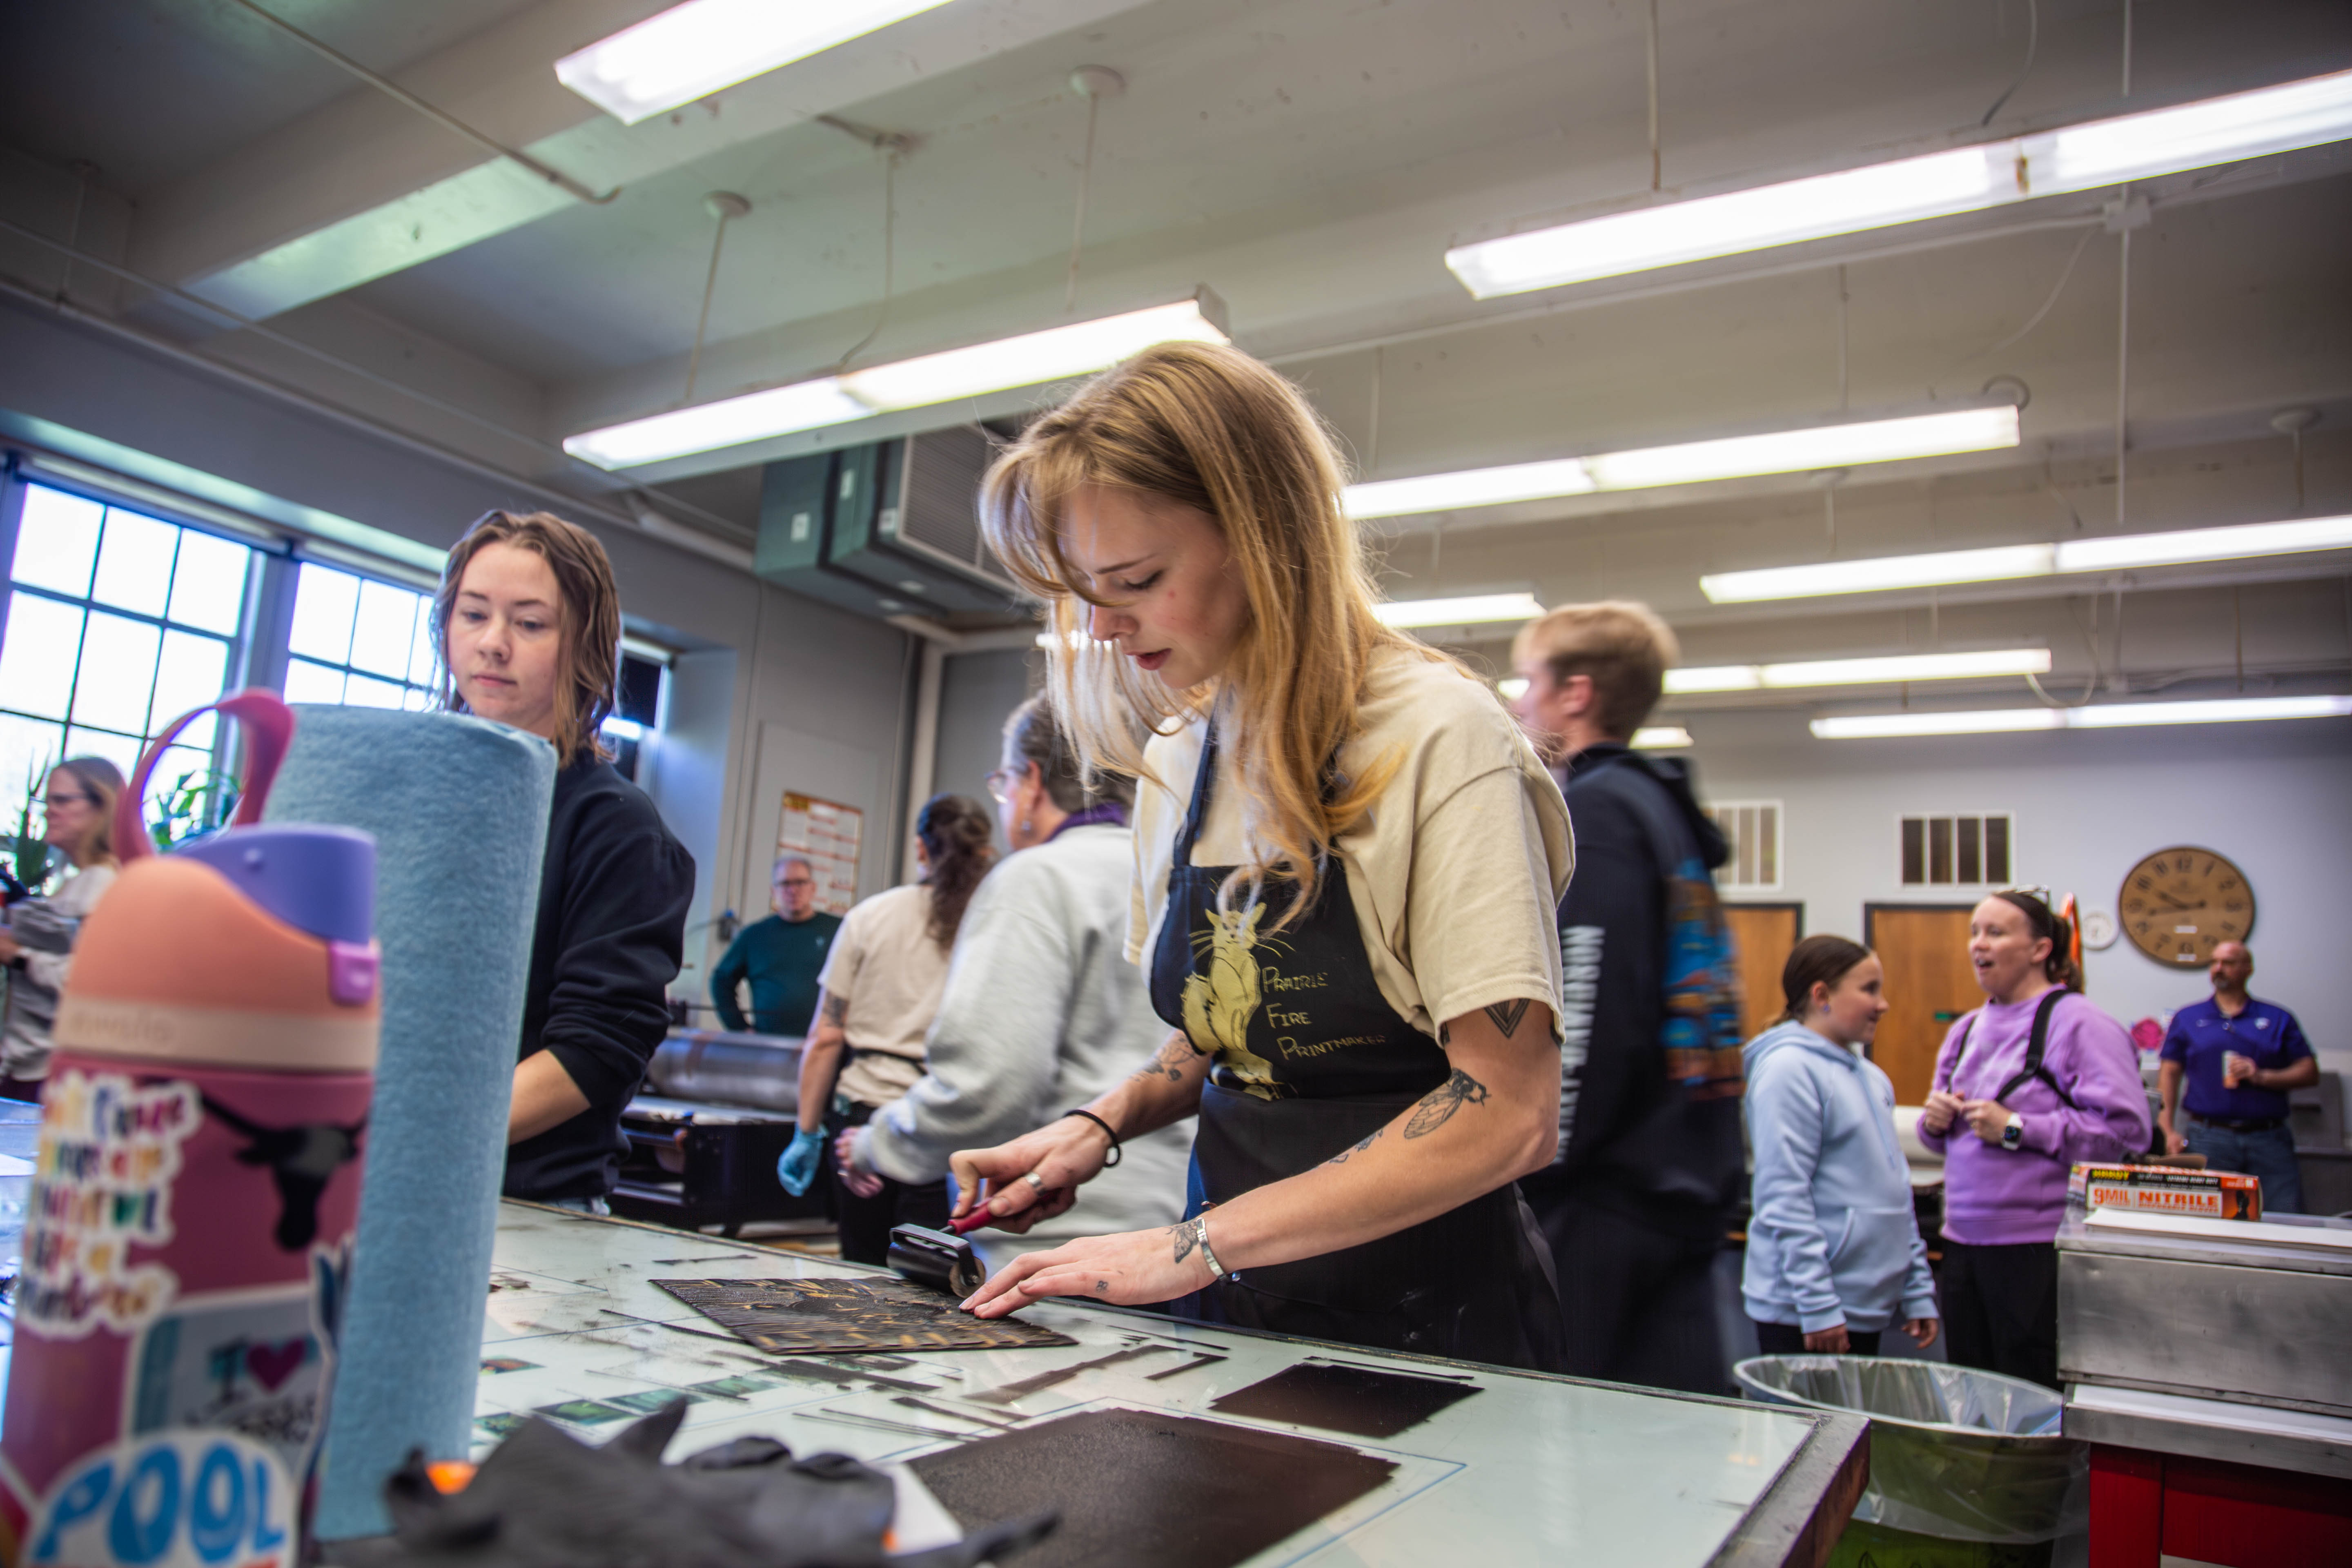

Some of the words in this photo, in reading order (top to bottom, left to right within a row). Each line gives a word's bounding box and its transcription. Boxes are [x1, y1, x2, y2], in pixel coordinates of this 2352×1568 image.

[1266, 1002, 1312, 1028] FIRE
[2138, 1191, 2219, 1206] NITRILE
[33, 1440, 286, 1565] POOL
